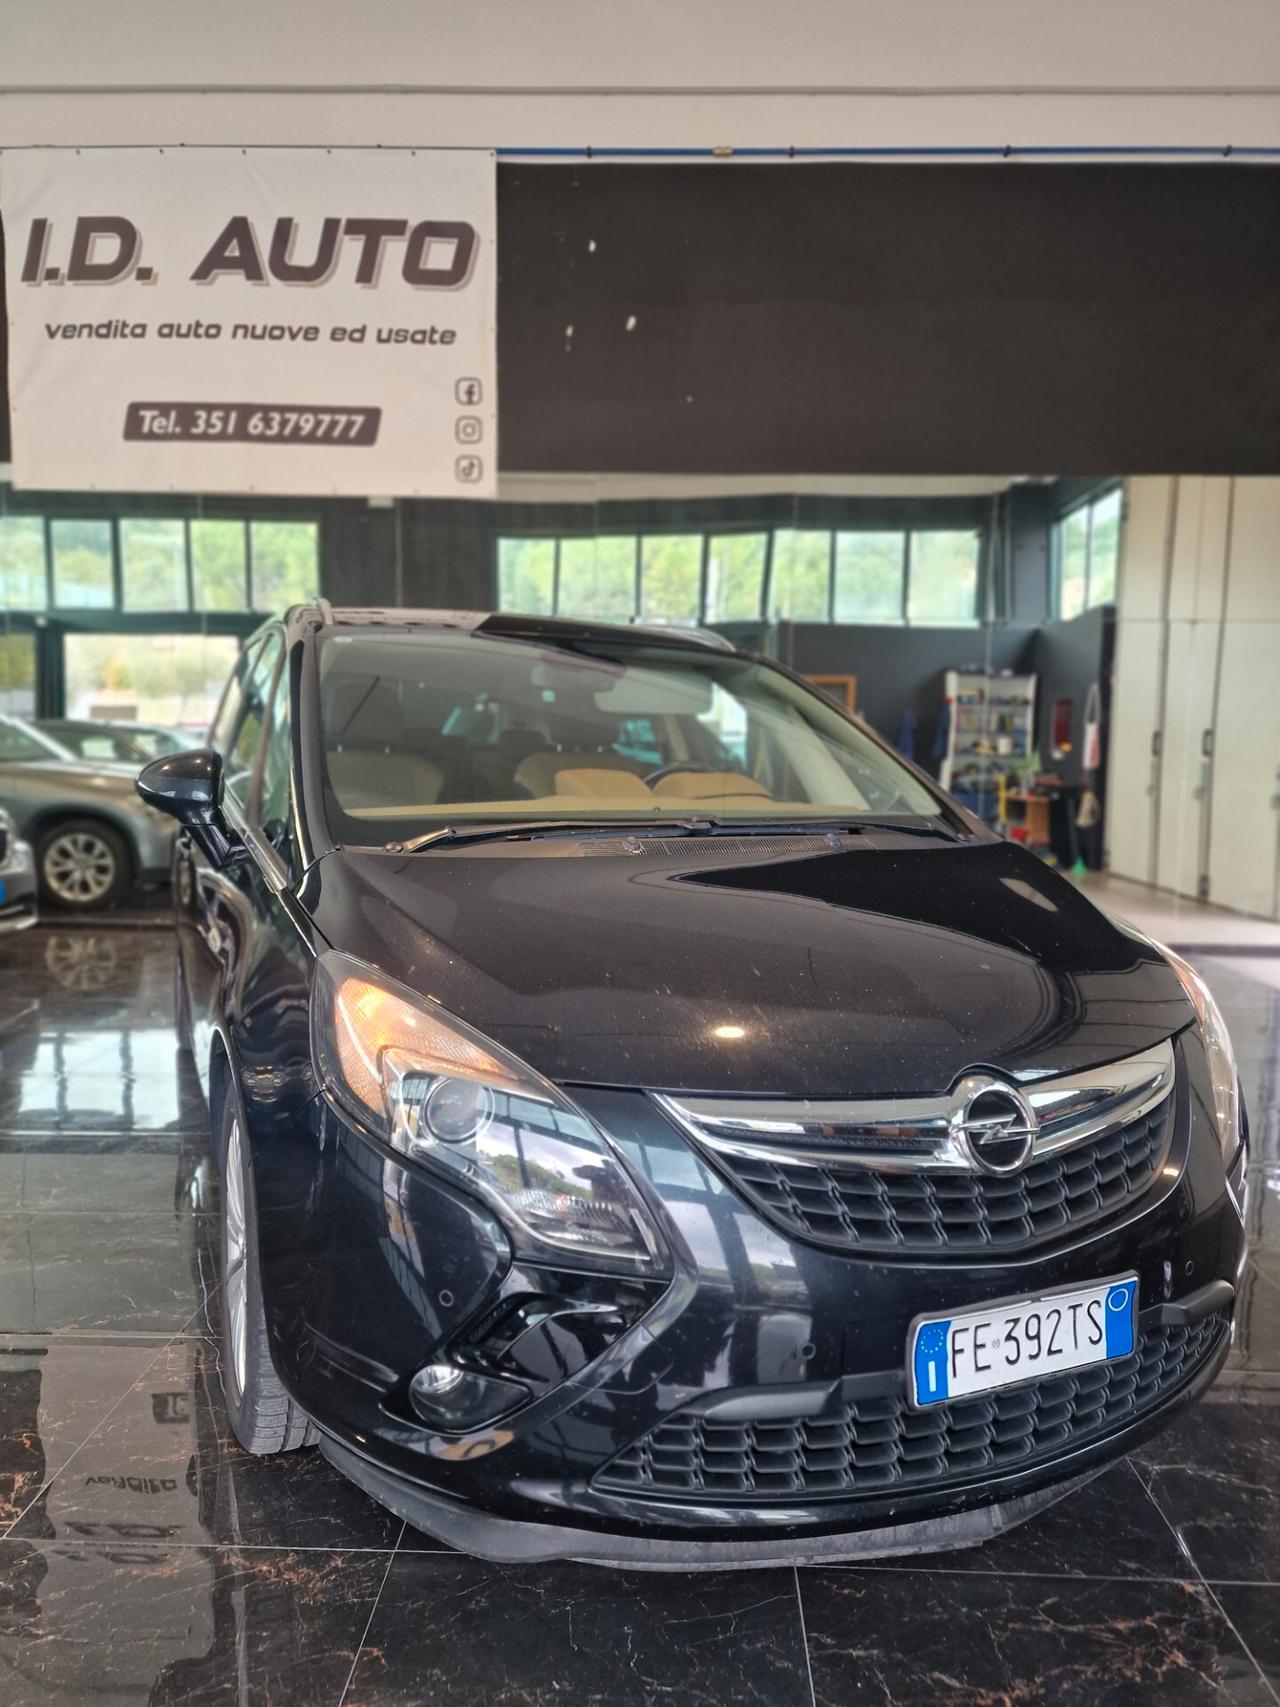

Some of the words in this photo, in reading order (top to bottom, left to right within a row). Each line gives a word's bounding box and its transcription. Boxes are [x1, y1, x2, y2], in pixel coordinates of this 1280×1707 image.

[21, 215, 156, 284] I.D.
[190, 215, 478, 289] AUTO
[45, 320, 147, 339] vendita
[157, 320, 222, 339] auto
[231, 324, 320, 342] nuove
[330, 324, 367, 343] ed
[376, 326, 457, 345] usate
[139, 410, 181, 434] Tel.
[191, 410, 237, 434] 351
[247, 412, 365, 438] 6379777
[928, 1360, 936, 1392] I
